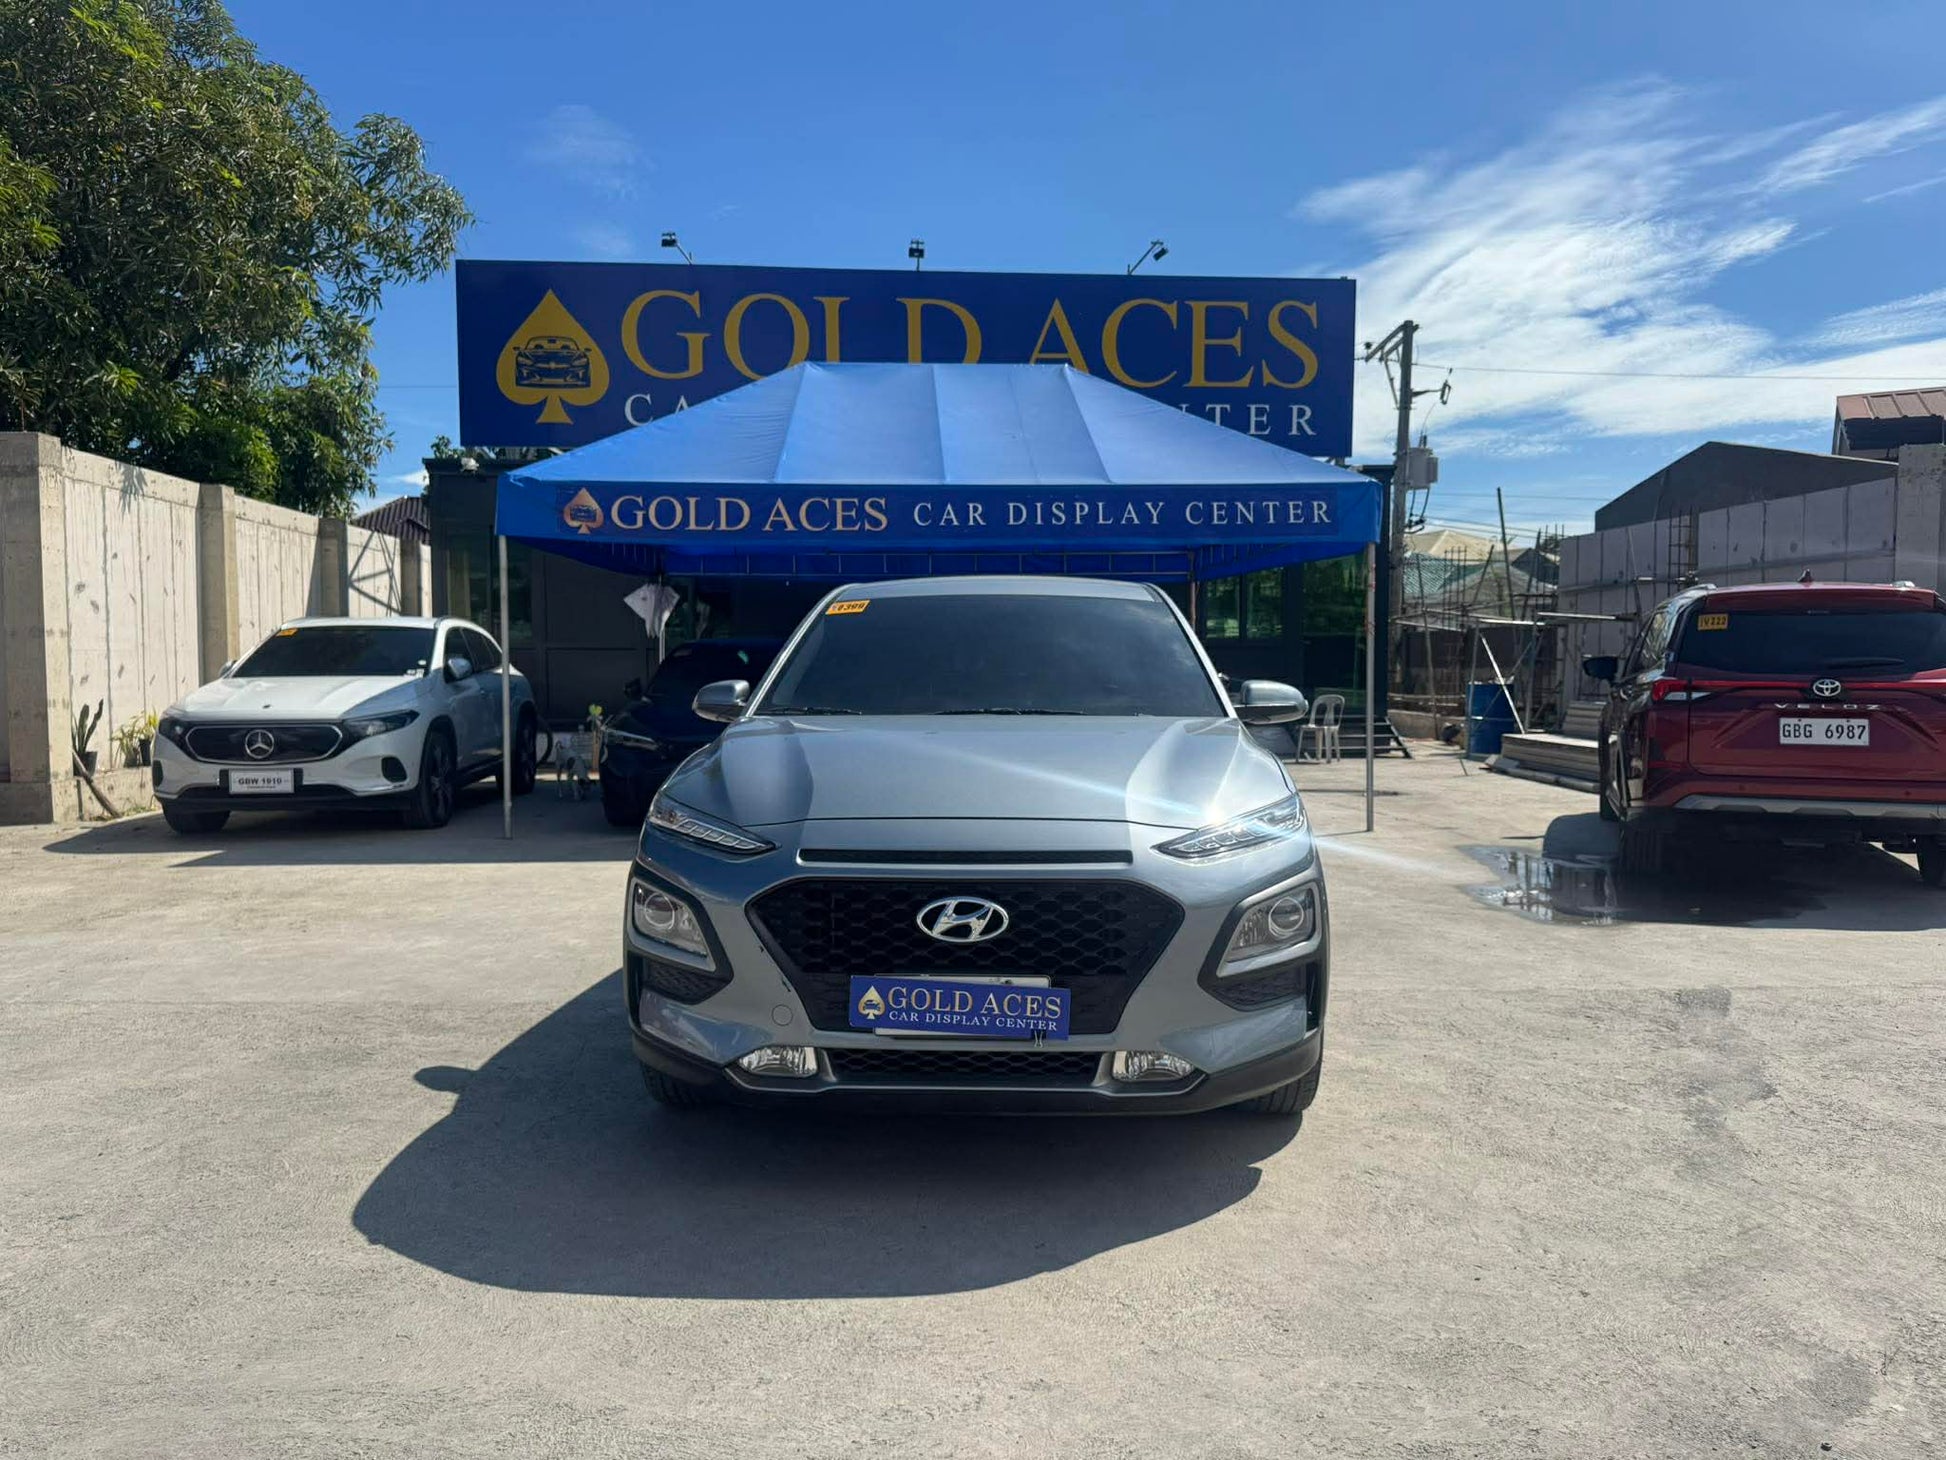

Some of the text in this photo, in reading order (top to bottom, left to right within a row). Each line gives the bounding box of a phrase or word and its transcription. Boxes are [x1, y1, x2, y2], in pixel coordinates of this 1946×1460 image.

[621, 289, 1319, 389] GOLD ACES
[1179, 403, 1318, 436] TER
[611, 496, 1332, 532] GOLD ACES CAR DISPLAY CENTER
[1774, 703, 1880, 711] VELOZ
[1782, 723, 1866, 739] GBG 6987
[888, 986, 1062, 1020] GOLD ACES
[889, 1010, 1057, 1032] CAR DISPLAY CENTER
